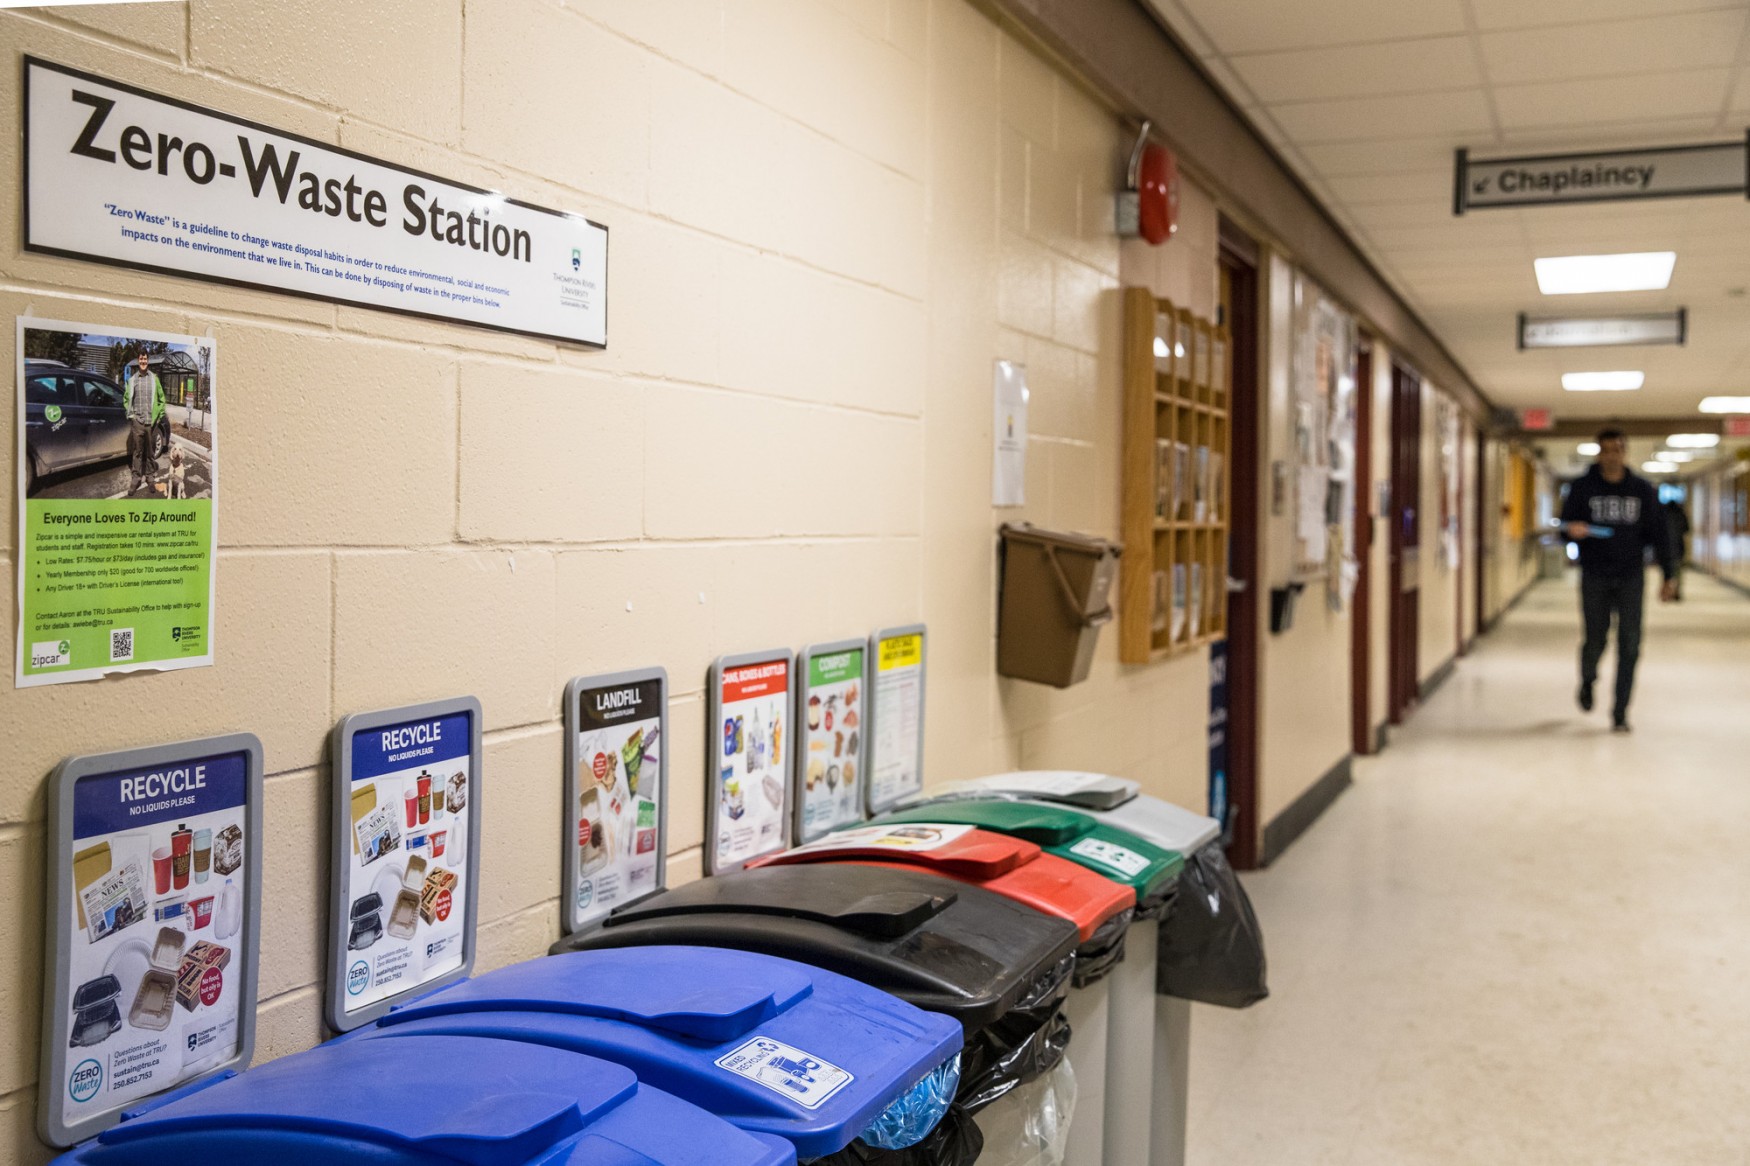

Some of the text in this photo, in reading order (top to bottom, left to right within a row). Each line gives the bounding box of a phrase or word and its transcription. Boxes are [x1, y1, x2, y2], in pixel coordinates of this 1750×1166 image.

[70, 89, 531, 262] Zero-Waste Station
[1497, 163, 1654, 193] Chaplaincy
[172, 217, 180, 228] is
[182, 222, 188, 230] a
[189, 223, 229, 239] guideline
[230, 231, 240, 241] to
[241, 232, 270, 248] change
[271, 240, 293, 251] waste
[294, 243, 323, 258] disposal
[324, 249, 345, 263] habits
[346, 255, 353, 264] in
[354, 258, 374, 269] order
[375, 261, 383, 270] to
[384, 264, 408, 276] reduce
[408, 269, 455, 285] environmental,
[457, 278, 474, 288] social
[474, 282, 485, 291] and
[485, 285, 510, 296] economic
[121, 225, 501, 308] impacts on the environment that we live in. This can be done by disposing of waste in the proper bins below.
[43, 511, 196, 526] Everyone Loves To Zip Around!
[36, 533, 53, 541] Zipcar
[96, 532, 128, 540] inexpensive
[153, 531, 170, 539] system
[60, 543, 71, 551] and
[87, 542, 118, 551] Registration
[135, 553, 157, 561] (includes
[45, 571, 62, 579] Yearly
[63, 569, 96, 577] Membership
[120, 568, 136, 576] (good
[45, 585, 57, 593] Any
[119, 580, 139, 588] License
[140, 579, 173, 587] (international
[35, 612, 58, 620] Contact
[106, 605, 140, 614] Sustainability
[140, 604, 156, 612] Office
[31, 654, 60, 668] zipcar
[596, 688, 642, 710] LANDFILL
[381, 721, 441, 752] RECYCLE
[388, 746, 434, 763] NO LIQUIDS PLEASE
[120, 765, 206, 803] RECYCLE
[129, 795, 196, 816] NO LIQUIDS PLEASE
[101, 879, 124, 896] NEWS
[350, 966, 368, 980] ZERO
[114, 1039, 160, 1059] Questions about
[114, 1058, 127, 1067] Zero
[127, 1052, 145, 1062] Waste
[153, 1043, 168, 1054] TRU?
[113, 1058, 160, 1079] sustain@tru.ca
[725, 1055, 746, 1067] MIXED
[736, 1051, 770, 1072] RECYCLING
[74, 1066, 99, 1083] ZERO
[113, 1070, 153, 1090] 250.852.7153
